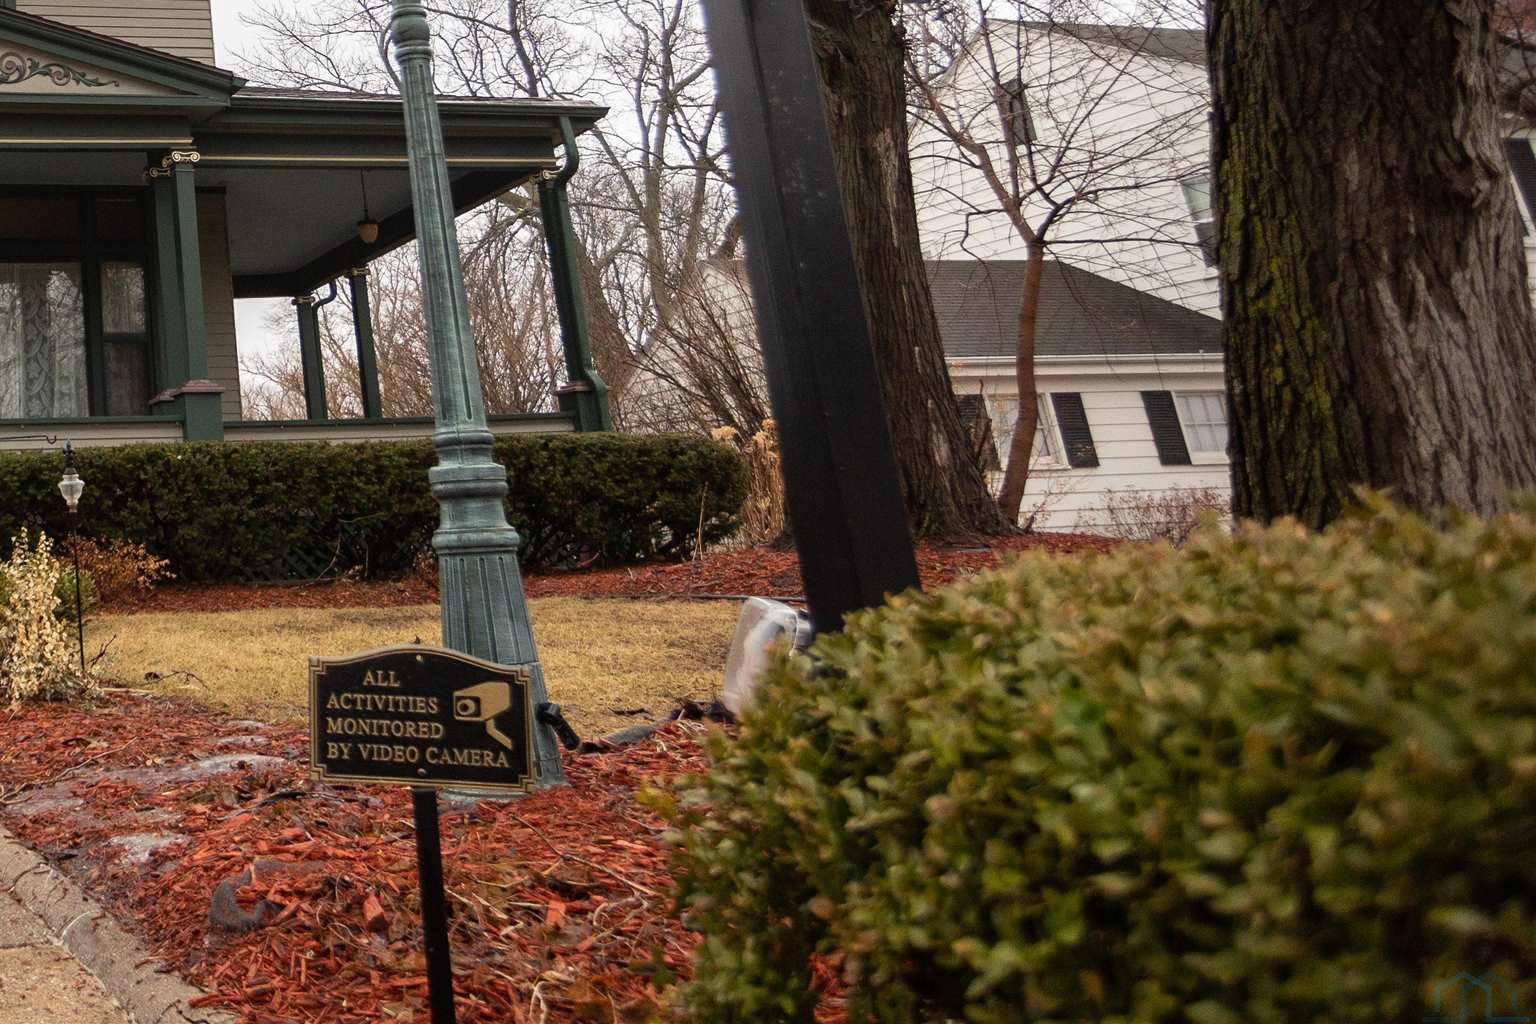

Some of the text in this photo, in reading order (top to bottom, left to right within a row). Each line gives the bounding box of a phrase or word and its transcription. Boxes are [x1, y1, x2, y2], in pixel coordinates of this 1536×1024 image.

[363, 669, 400, 688] ALL
[325, 693, 440, 714] ACTIVITIES
[326, 717, 444, 739] MONITORED
[326, 741, 510, 768] BY VIDEO CAMERA
